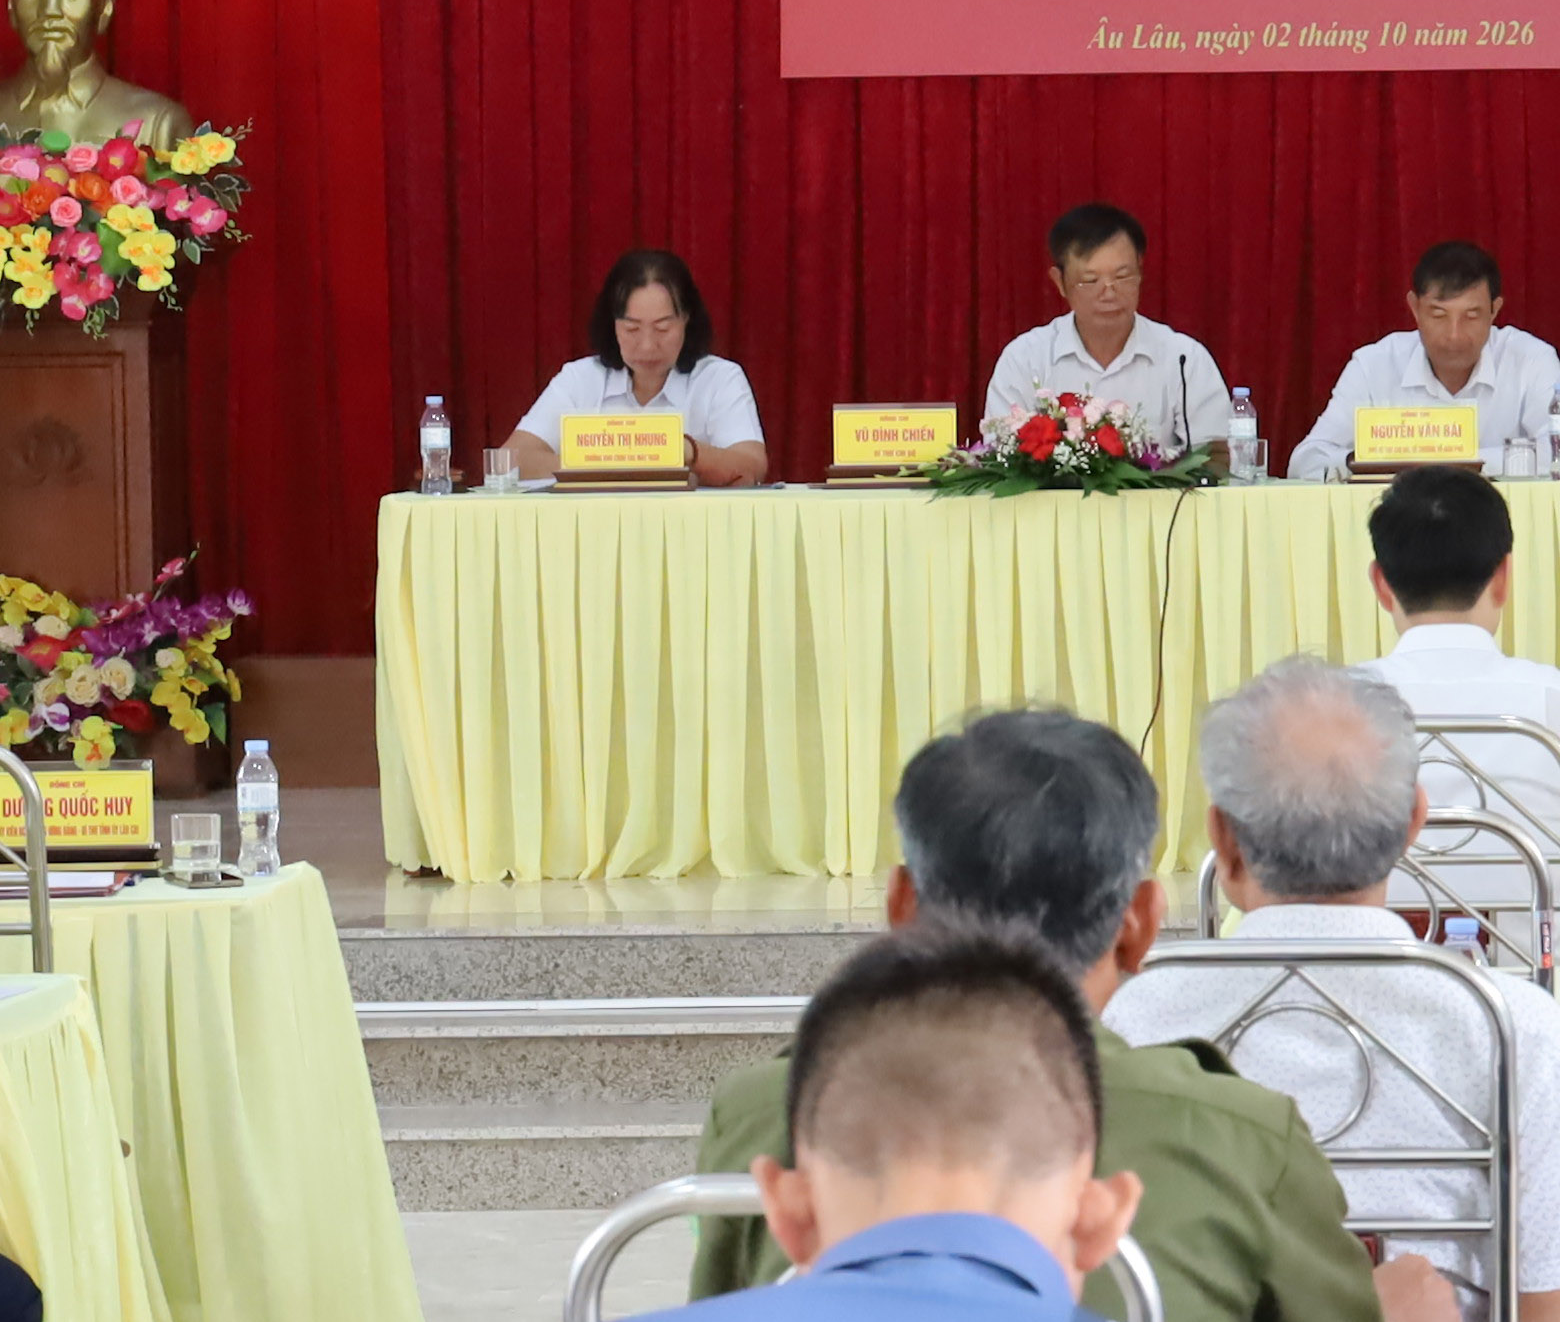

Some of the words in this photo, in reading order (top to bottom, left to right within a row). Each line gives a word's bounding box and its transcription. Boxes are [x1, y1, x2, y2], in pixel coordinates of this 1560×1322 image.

[1087, 17, 1123, 49] Âu
[1132, 24, 1186, 52] Lâu,
[1195, 23, 1254, 54] ngày
[1263, 23, 1291, 47] 02
[1299, 22, 1369, 53] tháng
[1379, 22, 1407, 46] 10
[1414, 23, 1467, 45] năm
[1476, 21, 1534, 45] 2026
[2, 796, 54, 817] DƯG
[59, 789, 99, 820] QUỐC
[104, 796, 133, 817] HUY
